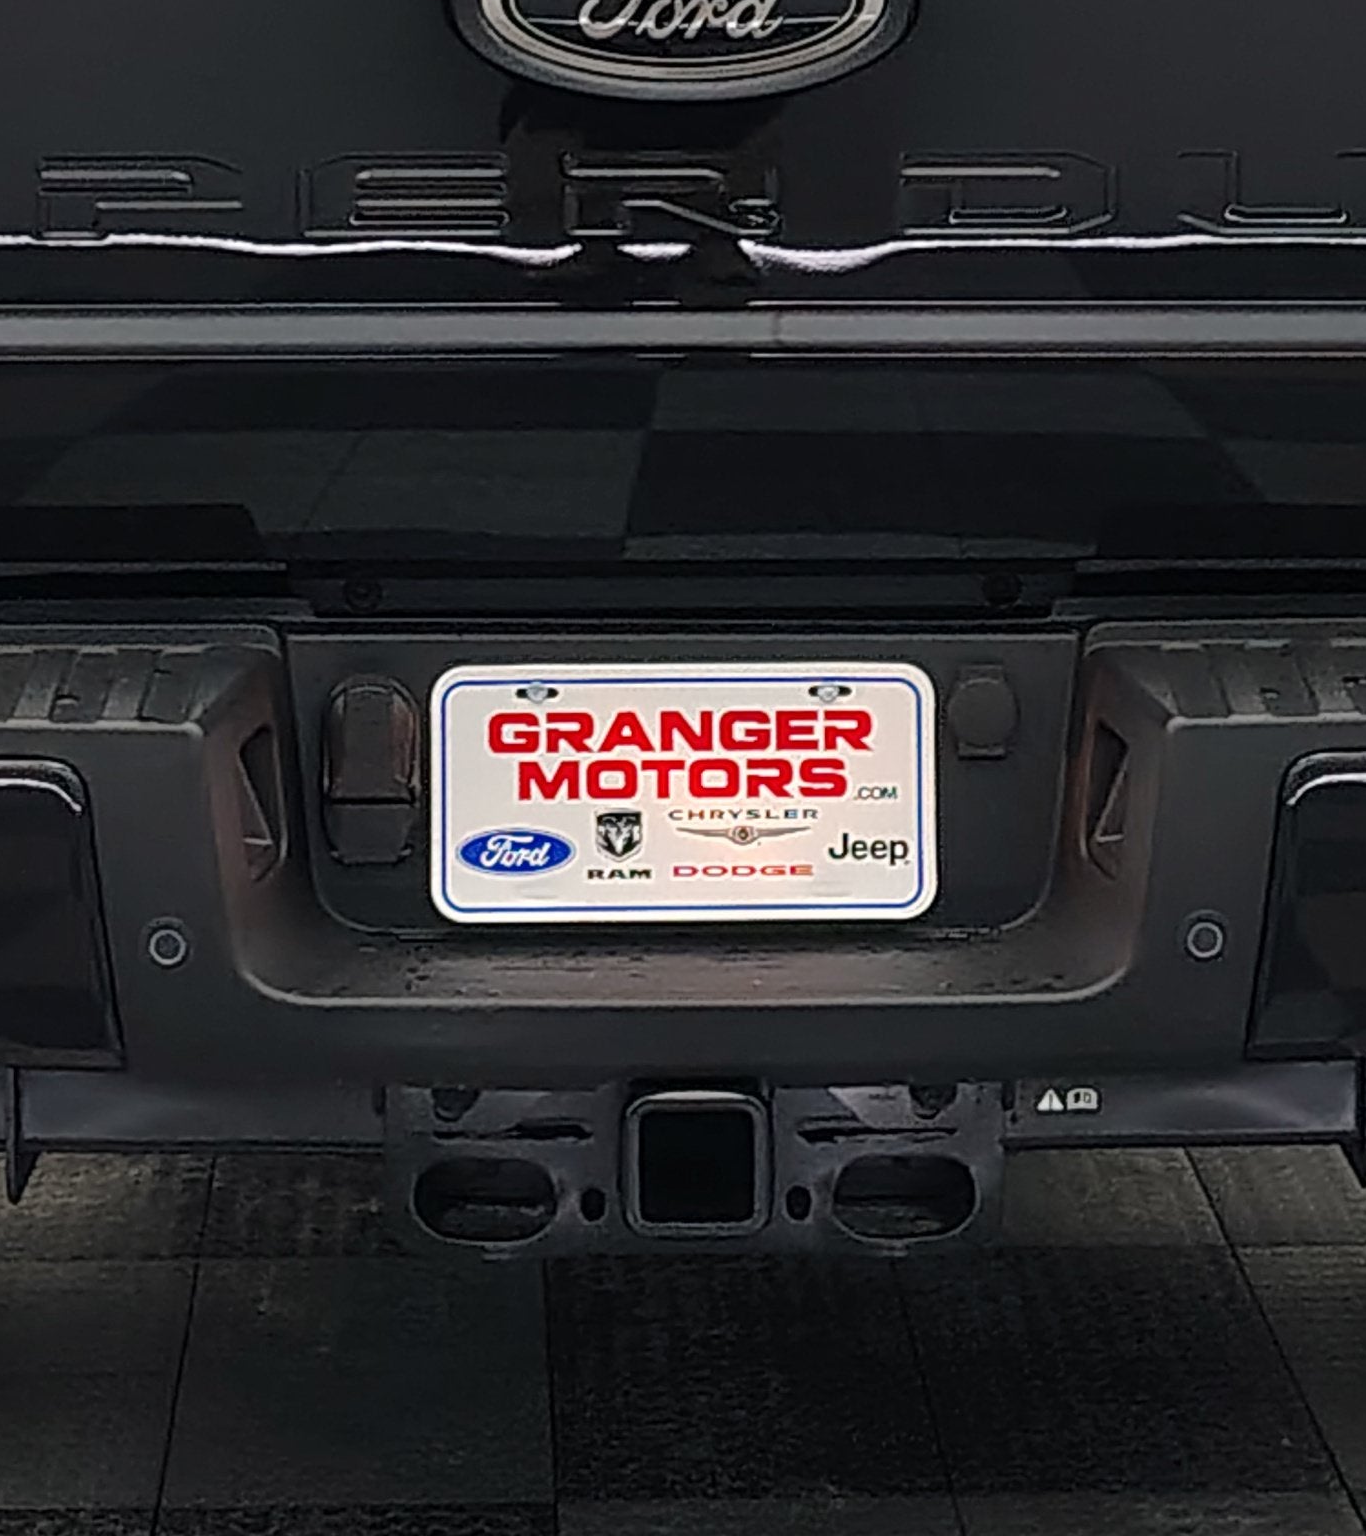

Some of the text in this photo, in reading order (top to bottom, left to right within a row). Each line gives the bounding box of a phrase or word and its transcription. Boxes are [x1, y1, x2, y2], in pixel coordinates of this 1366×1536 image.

[488, 710, 873, 753] GRANGER
[518, 759, 848, 801] MOTORS
[668, 808, 820, 821] CHRYSLER
[480, 835, 551, 868] Ford
[828, 833, 909, 865] Jeep
[587, 868, 653, 880] RAM
[673, 865, 814, 877] DODGE
